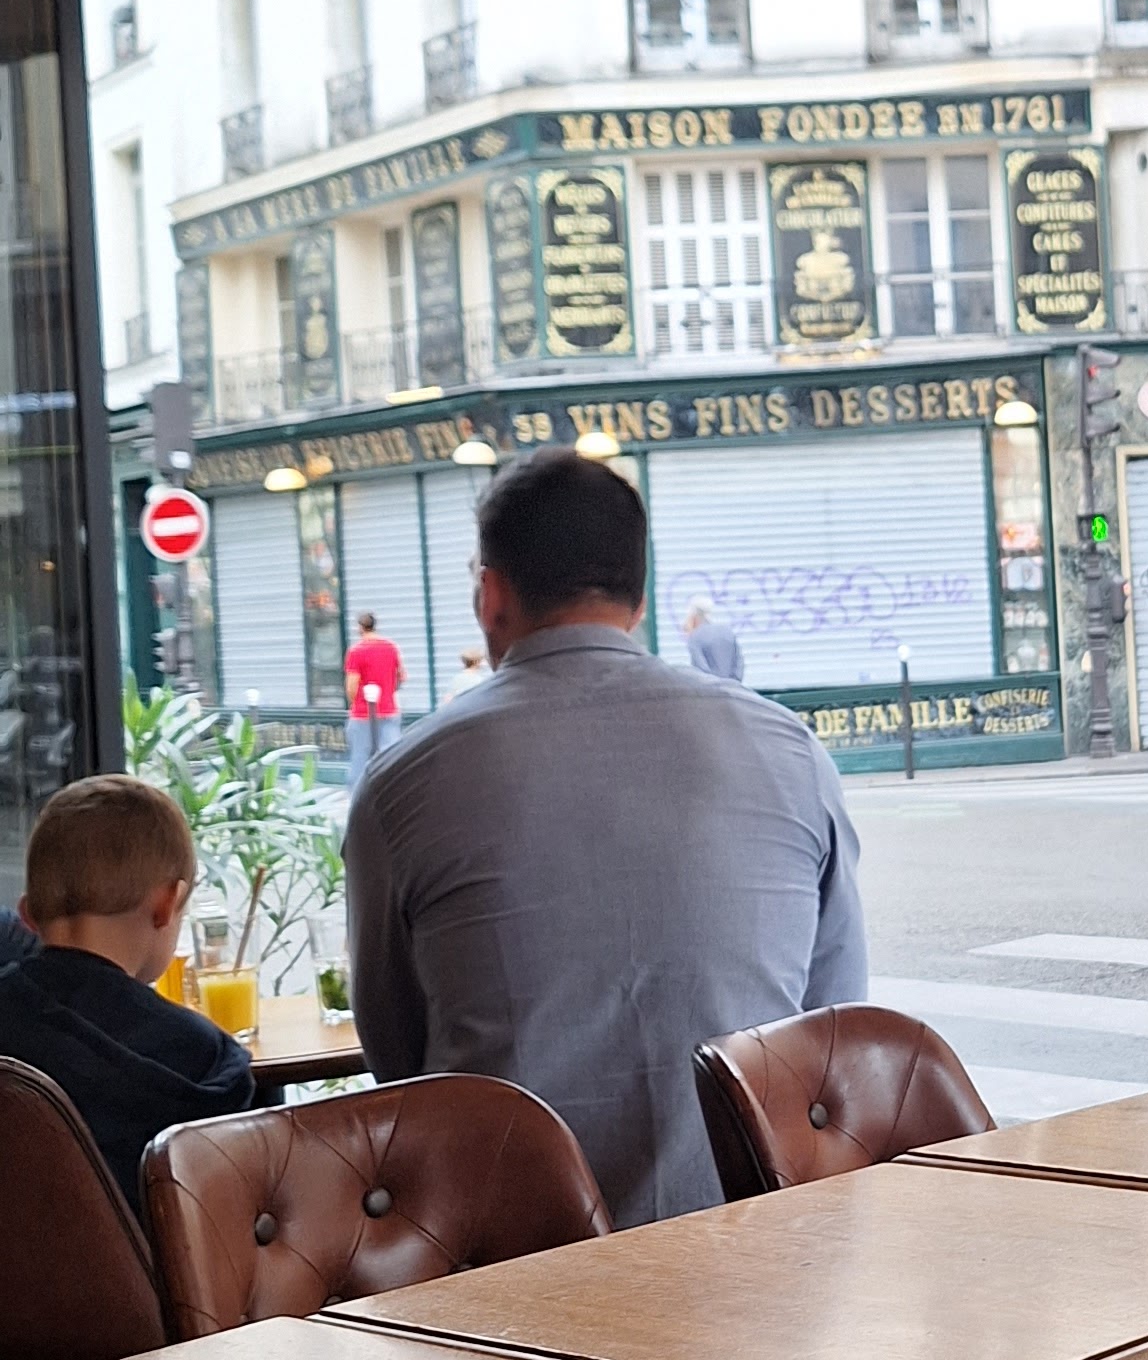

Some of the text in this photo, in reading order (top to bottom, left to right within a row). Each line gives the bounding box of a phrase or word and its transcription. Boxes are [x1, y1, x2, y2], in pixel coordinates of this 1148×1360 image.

[559, 110, 734, 150] MAISON
[937, 103, 984, 135] EN
[991, 94, 1066, 133] 1761
[567, 400, 672, 440] VINS
[693, 392, 790, 437] FINS
[811, 375, 1018, 428] DESSERTS
[814, 708, 850, 736] DE
